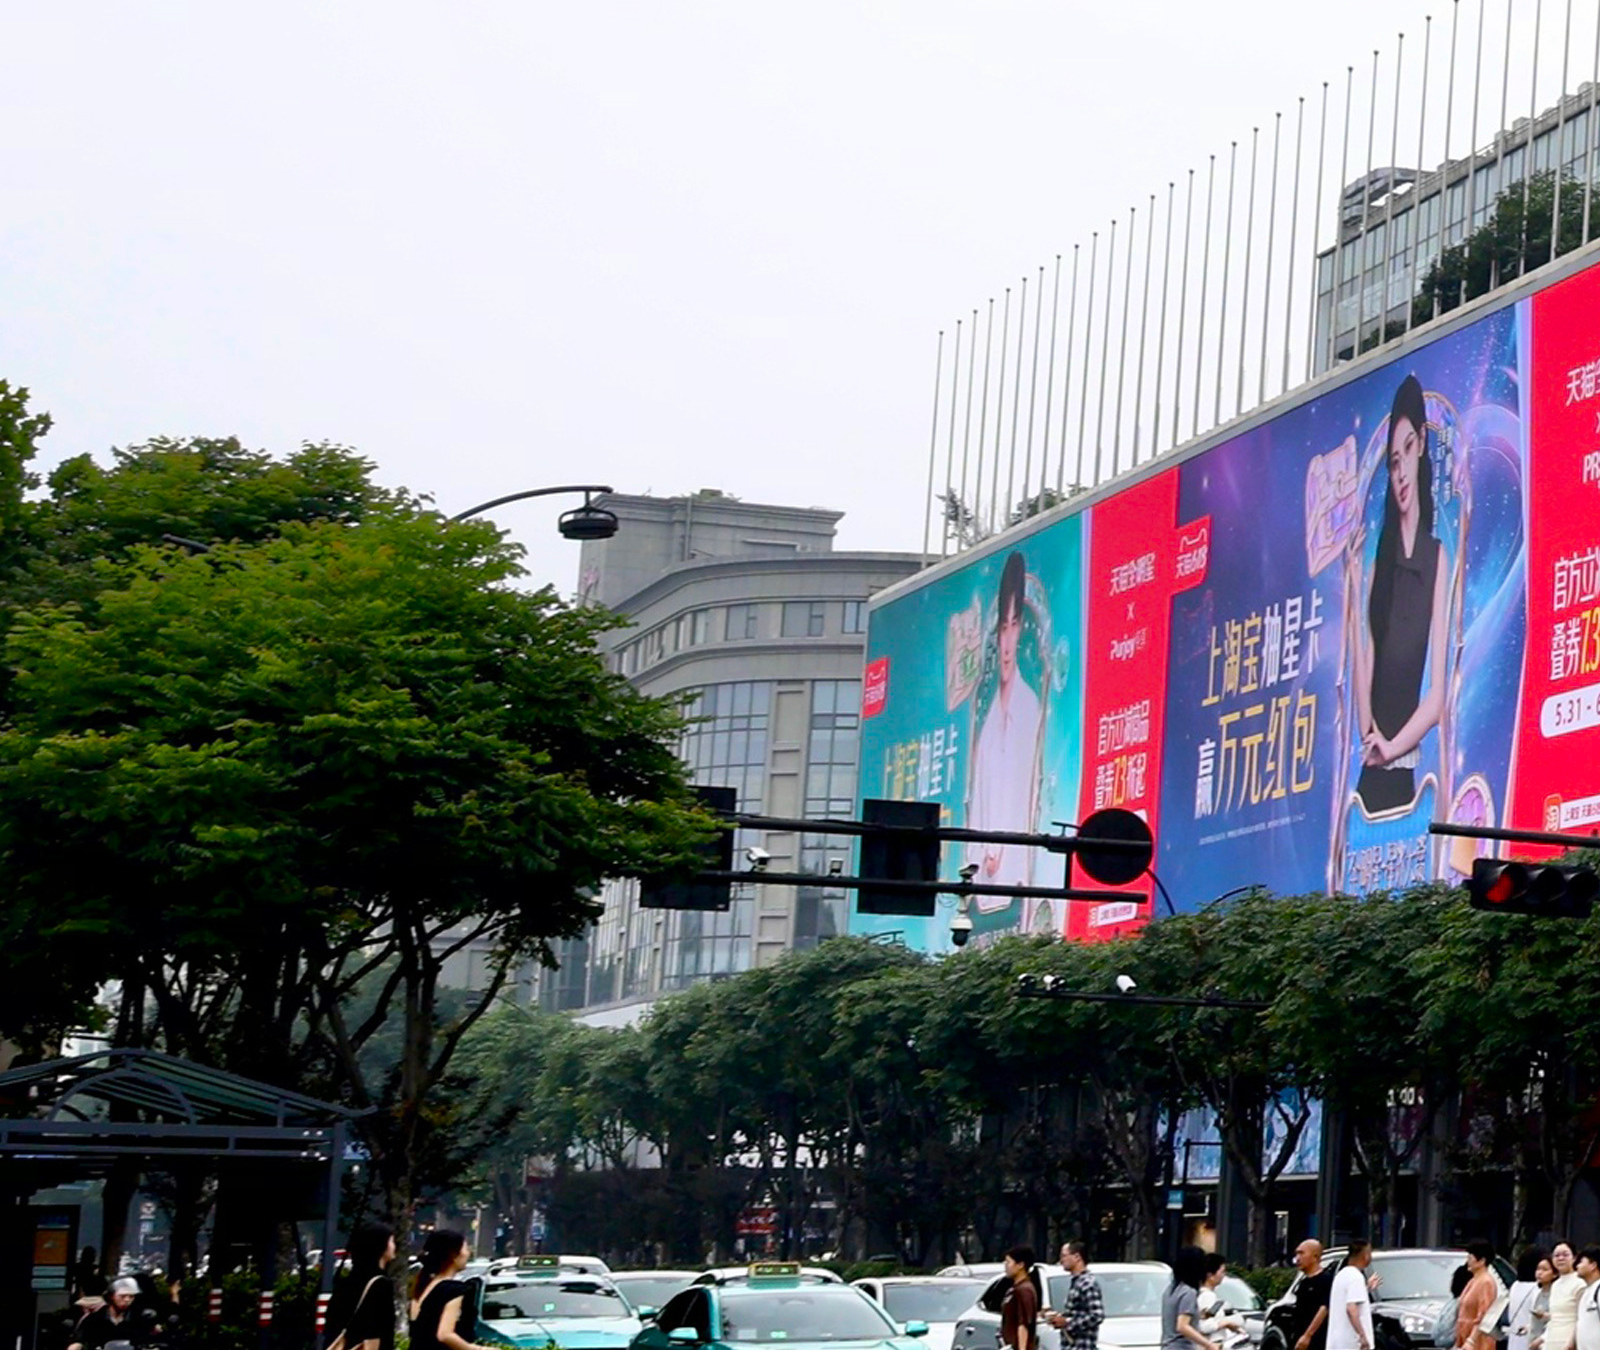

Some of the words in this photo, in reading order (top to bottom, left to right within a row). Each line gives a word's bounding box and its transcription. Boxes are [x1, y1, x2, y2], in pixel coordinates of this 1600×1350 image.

[1202, 588, 1323, 707] 上淘宝抽星卡
